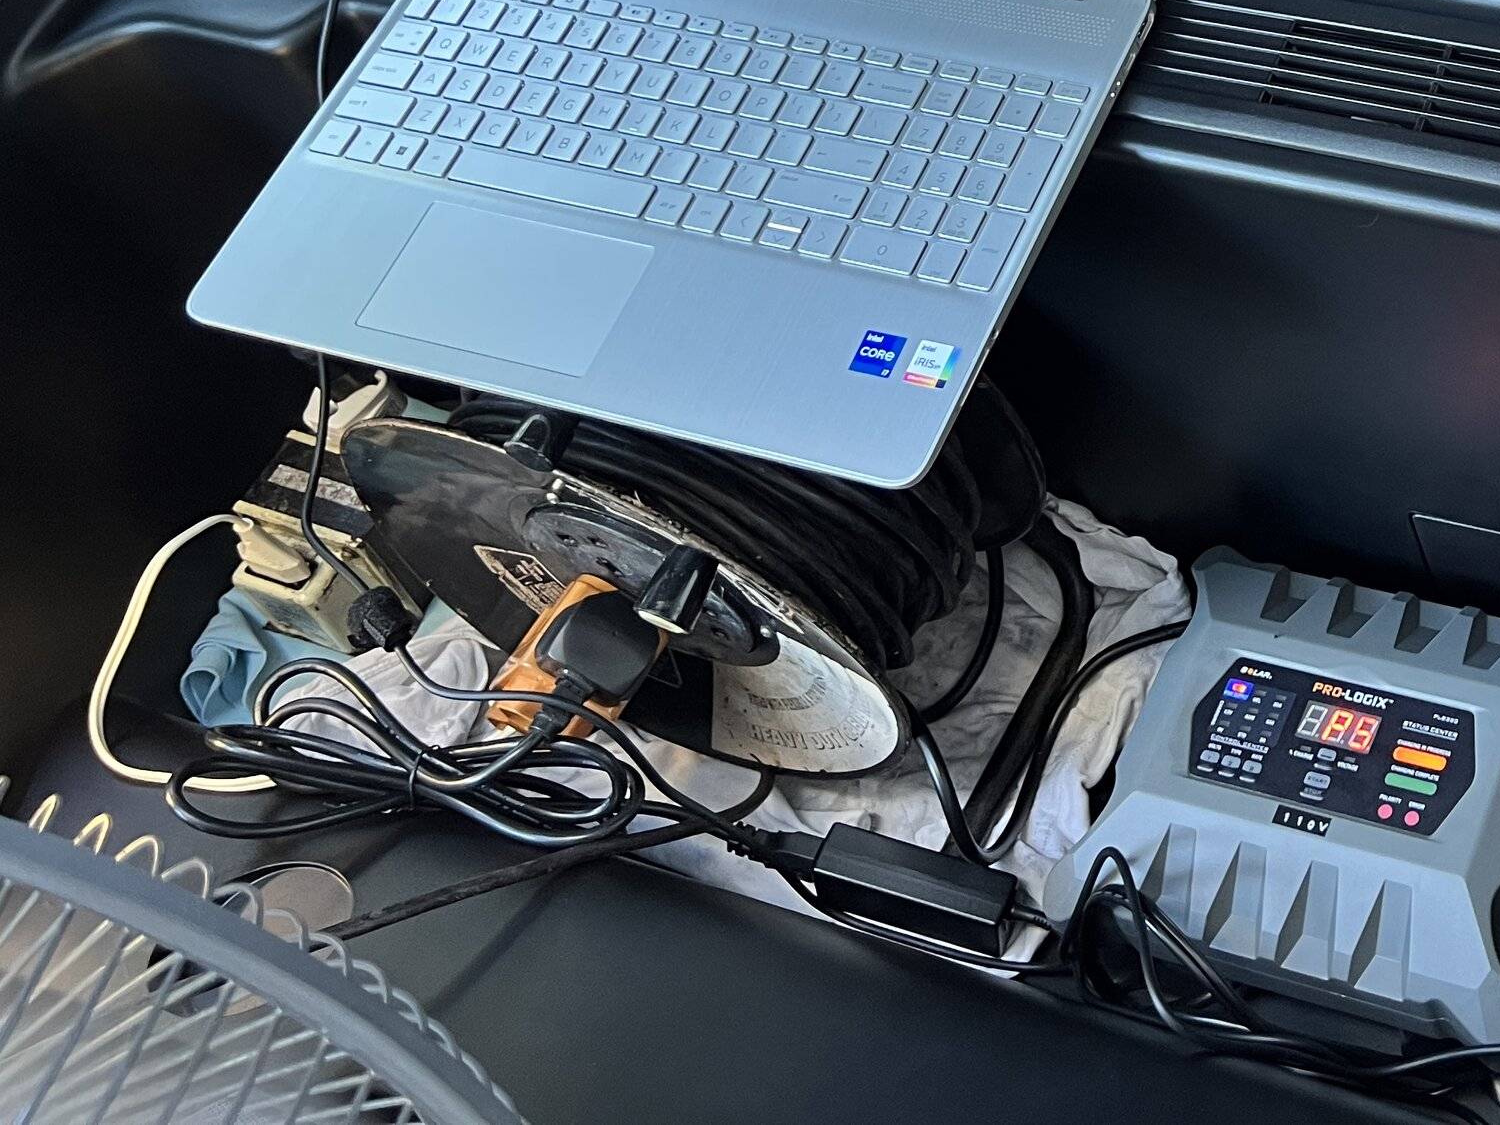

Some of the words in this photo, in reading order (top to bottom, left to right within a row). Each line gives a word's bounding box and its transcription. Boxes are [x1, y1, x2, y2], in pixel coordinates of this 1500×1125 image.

[865, 333, 884, 343] intel
[921, 344, 938, 353] intel
[751, 724, 808, 750] HEAVY
[809, 727, 850, 751] DUTY
[1402, 720, 1430, 733] STATUS
[1430, 727, 1459, 739] CENTER
[1210, 733, 1241, 747] CONTROL
[1243, 741, 1269, 754] CENTER
